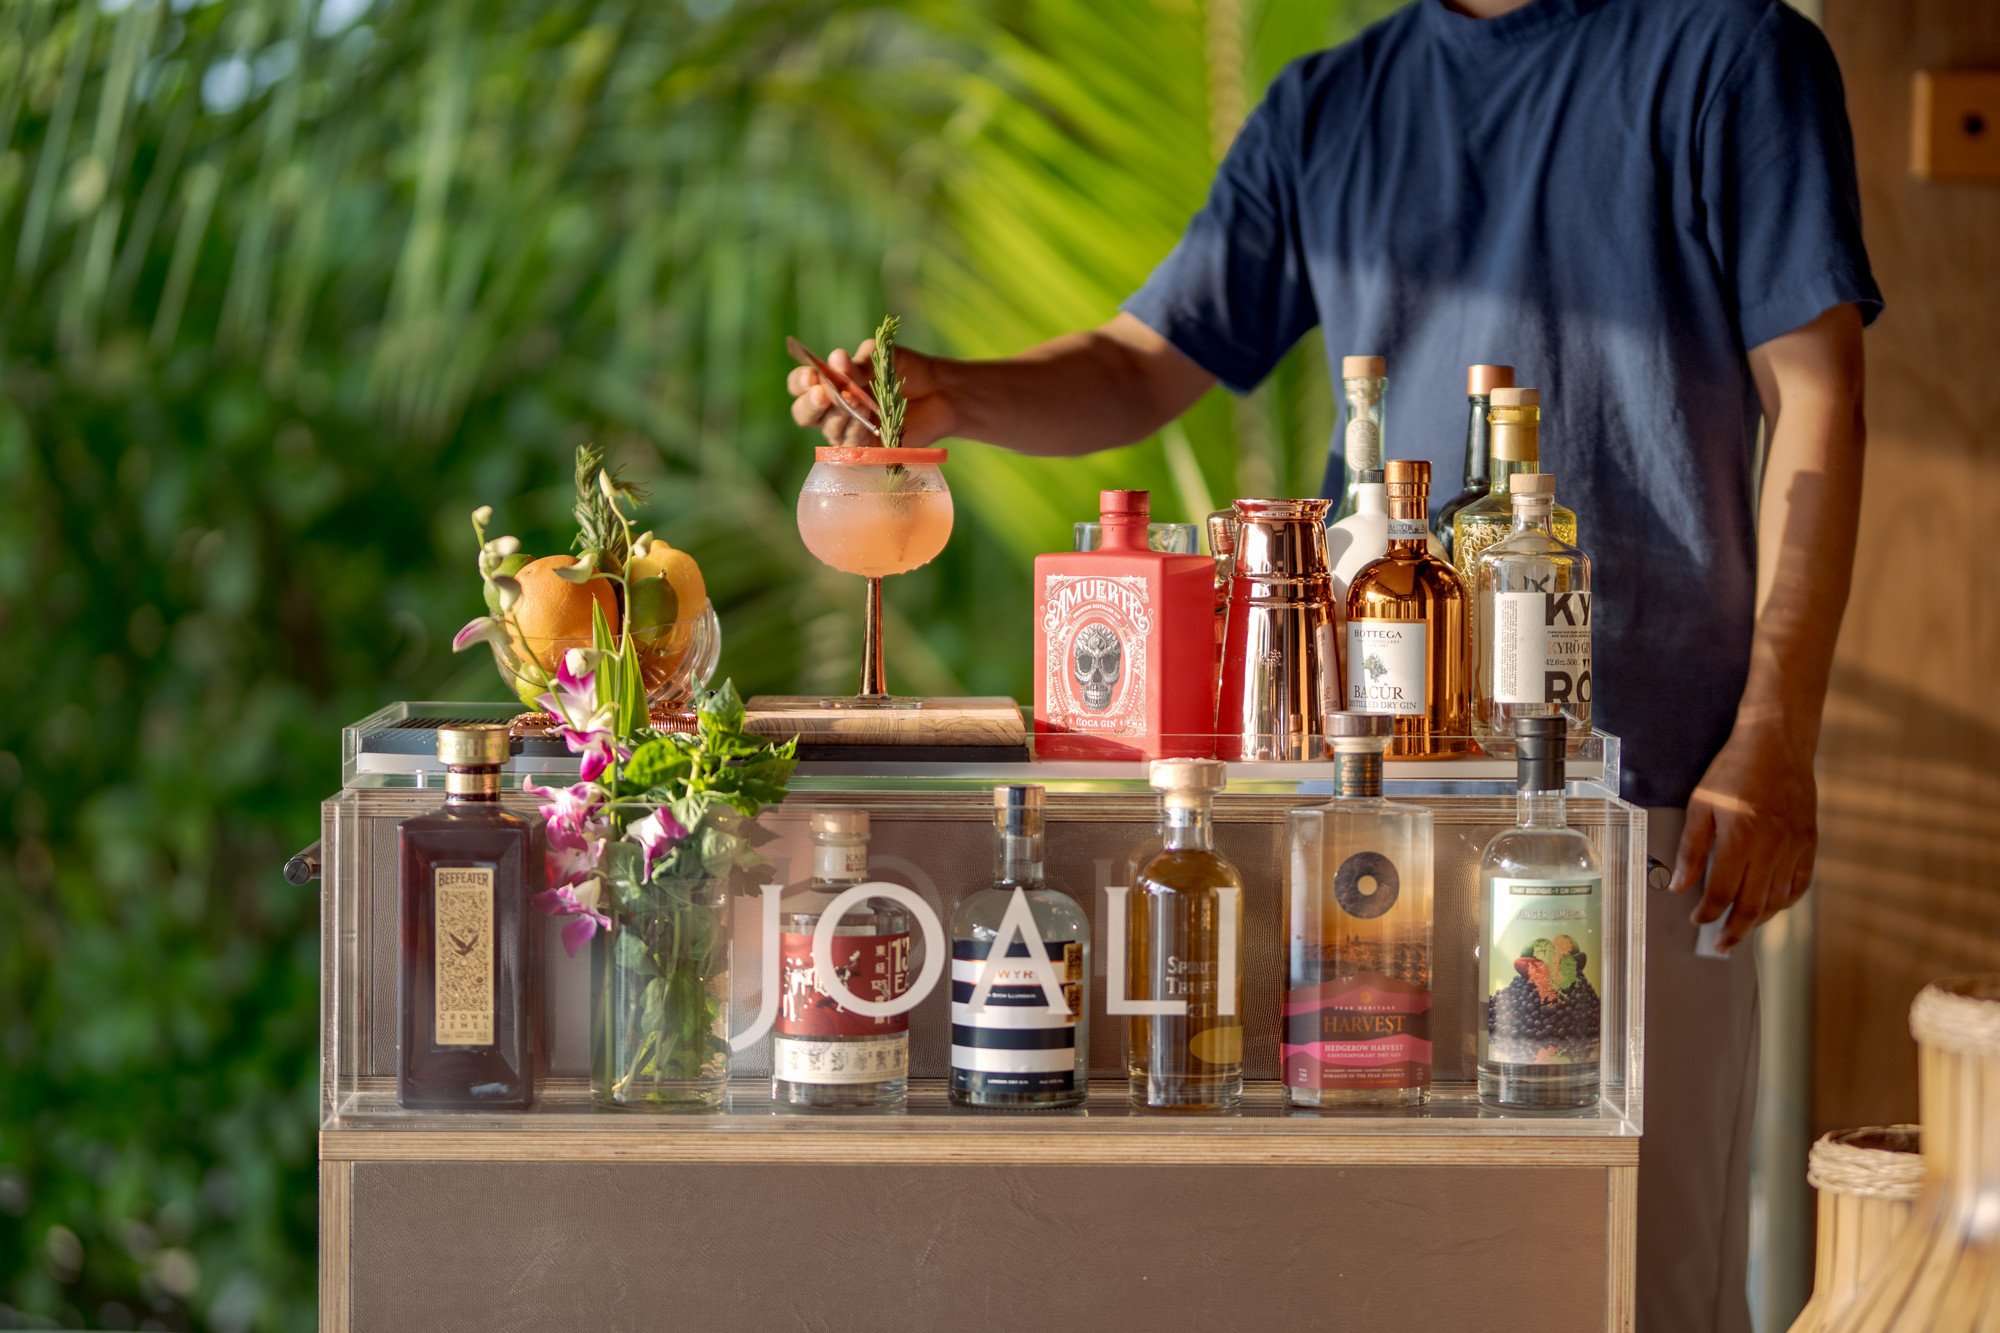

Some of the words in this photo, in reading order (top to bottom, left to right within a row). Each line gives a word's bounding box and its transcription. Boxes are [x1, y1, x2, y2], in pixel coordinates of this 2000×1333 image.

[1044, 580, 1150, 636] AMUERTE
[1354, 629, 1402, 639] BOTTEGA
[1547, 639, 1581, 655] KYRÖ
[1354, 682, 1404, 700] BACÛR
[1380, 701, 1398, 709] DRY
[1399, 701, 1417, 710] GIN
[1076, 717, 1098, 727] COCA
[1100, 718, 1118, 728] GIN
[438, 872, 489, 887] BEEFEATER
[1550, 909, 1571, 920] LIME
[729, 882, 1238, 1051] JOALI
[439, 1013, 489, 1021] CROWN
[440, 1021, 489, 1029] JEWEL
[1324, 1015, 1406, 1033] HARVEST
[1324, 1044, 1369, 1052] HEDGEROW
[1370, 1043, 1405, 1052] HARVEST
